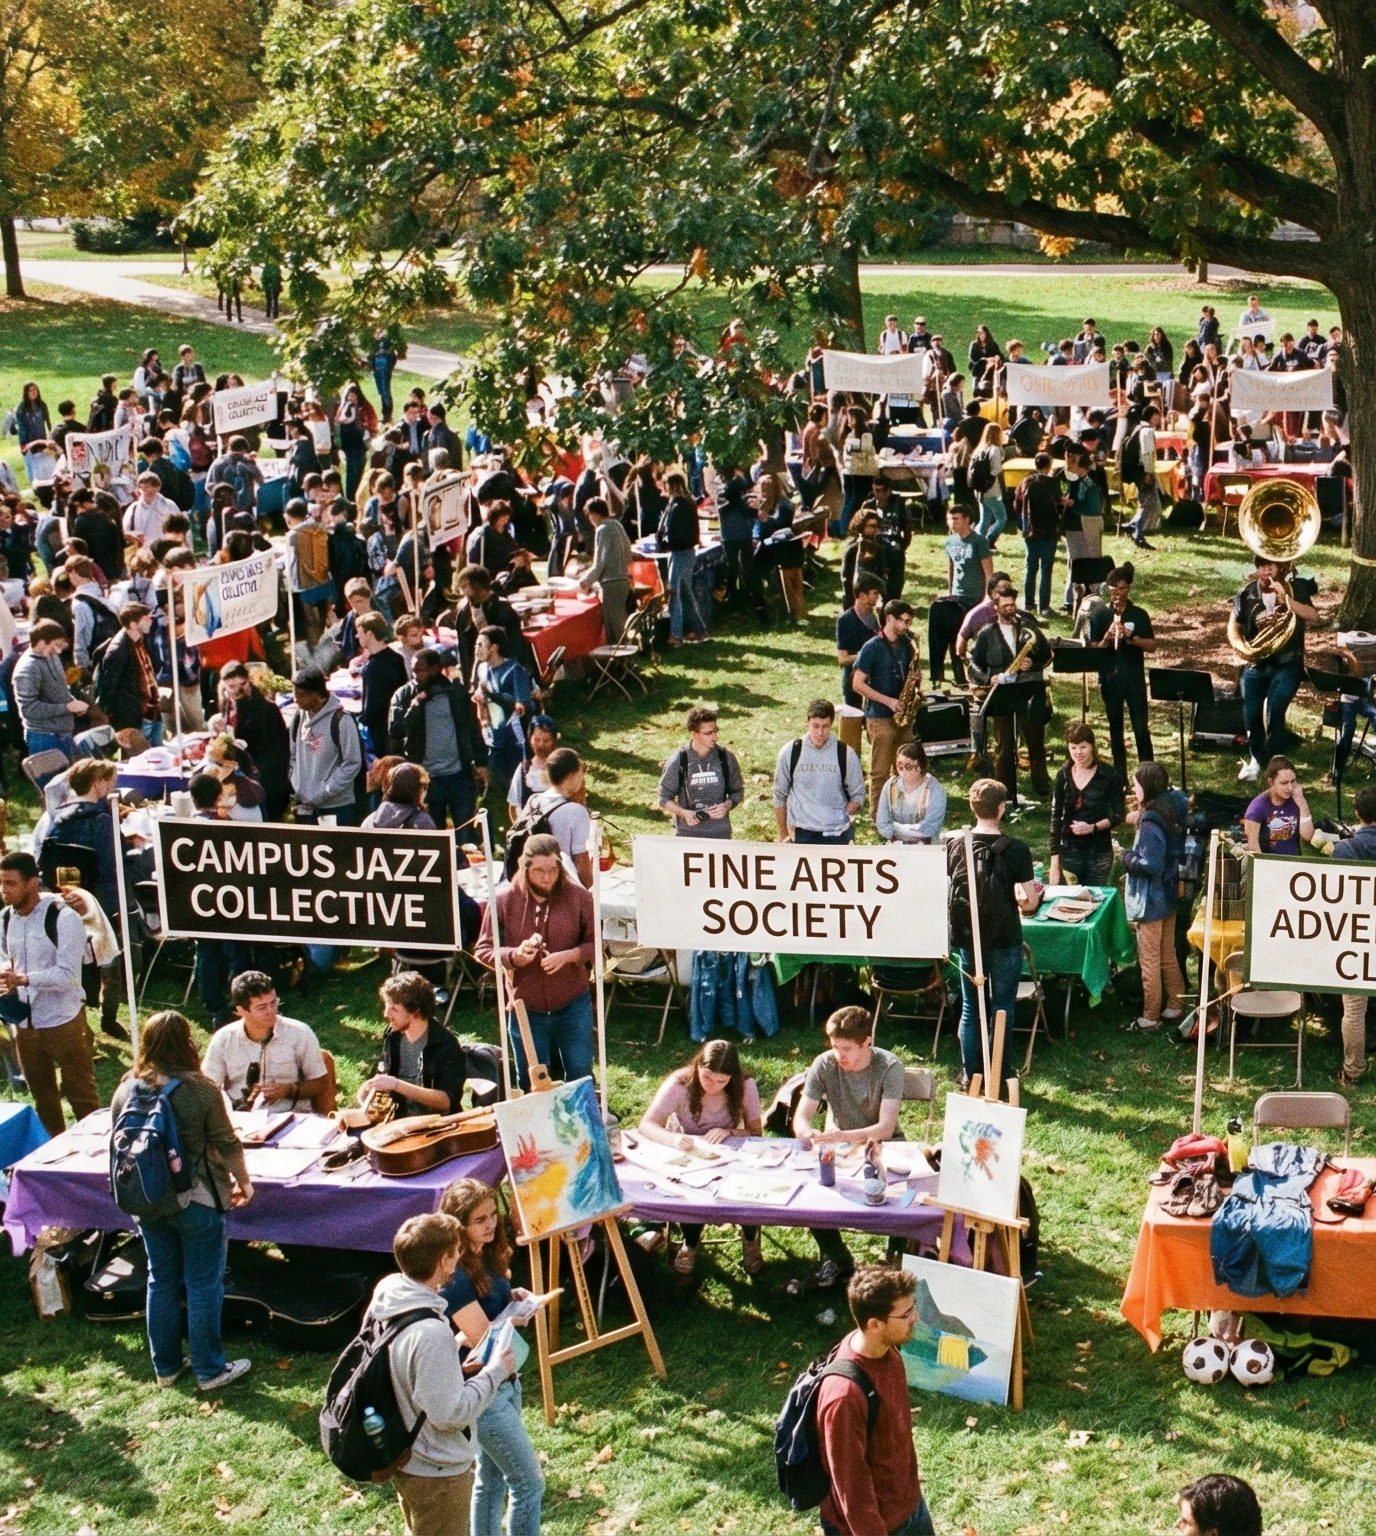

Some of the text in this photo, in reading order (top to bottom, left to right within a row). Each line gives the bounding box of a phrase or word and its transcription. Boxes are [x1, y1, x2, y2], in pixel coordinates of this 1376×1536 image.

[170, 837, 442, 884] CAMPUS JAZZ
[683, 852, 900, 895] FINE ARTS
[190, 883, 427, 928] COLLECTIVE
[702, 898, 882, 940] SOCIETY
